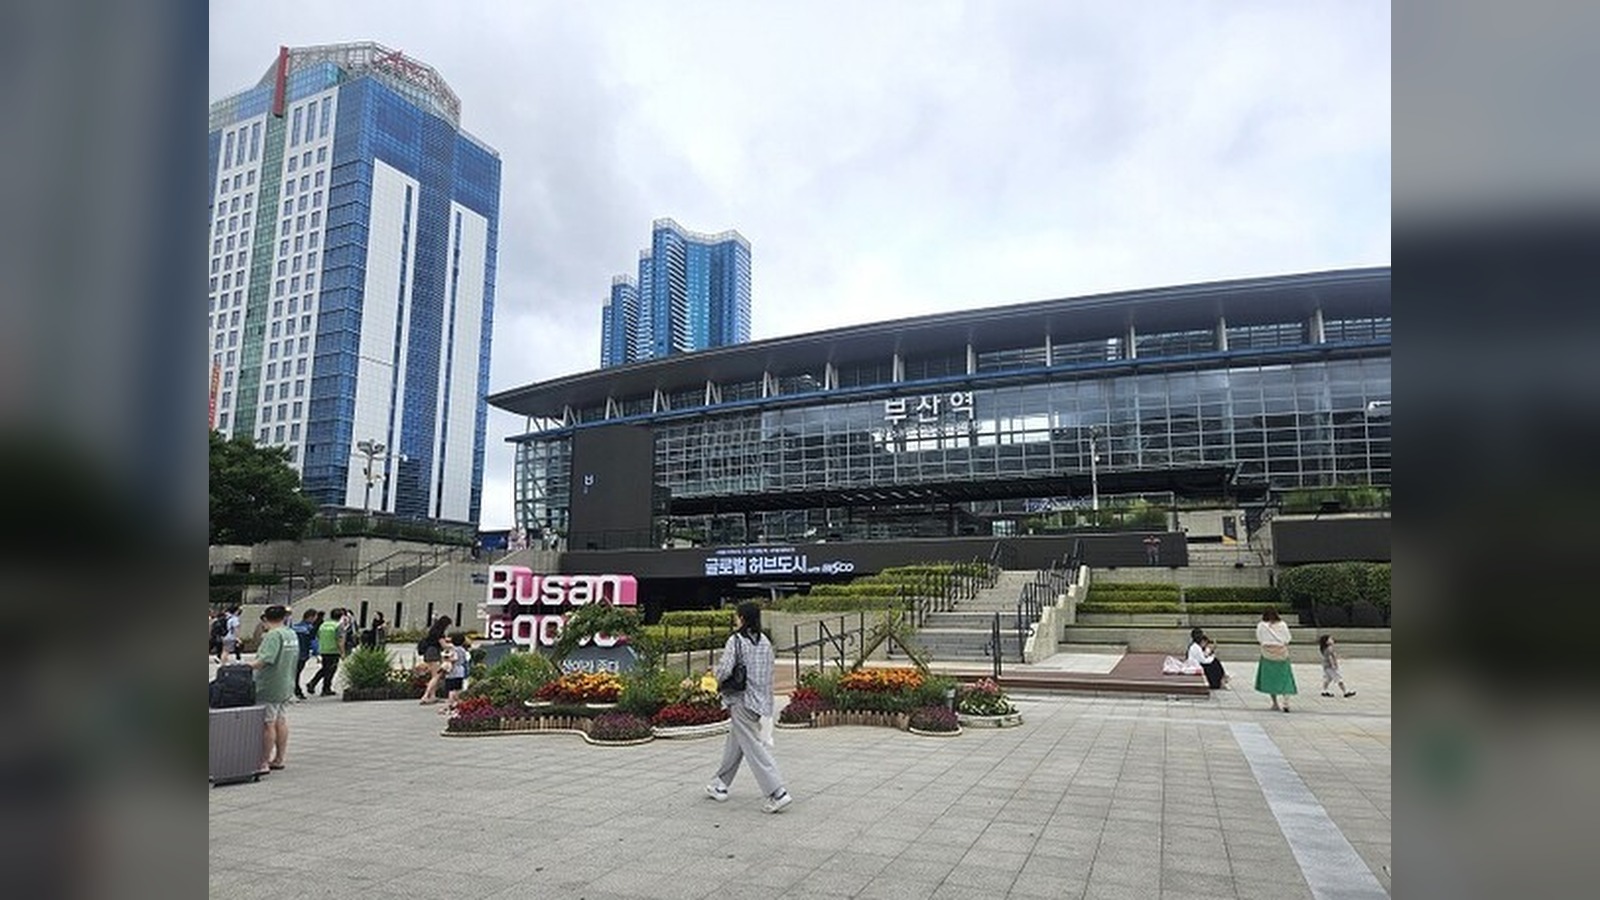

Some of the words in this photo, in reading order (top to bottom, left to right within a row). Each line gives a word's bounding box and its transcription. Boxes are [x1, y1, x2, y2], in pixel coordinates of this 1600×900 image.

[884, 391, 973, 425] 부산역
[705, 557, 747, 576] 글로벌
[749, 555, 807, 574] 허브도시
[487, 565, 621, 605] Busan
[485, 614, 506, 639] is
[512, 614, 620, 654] go
